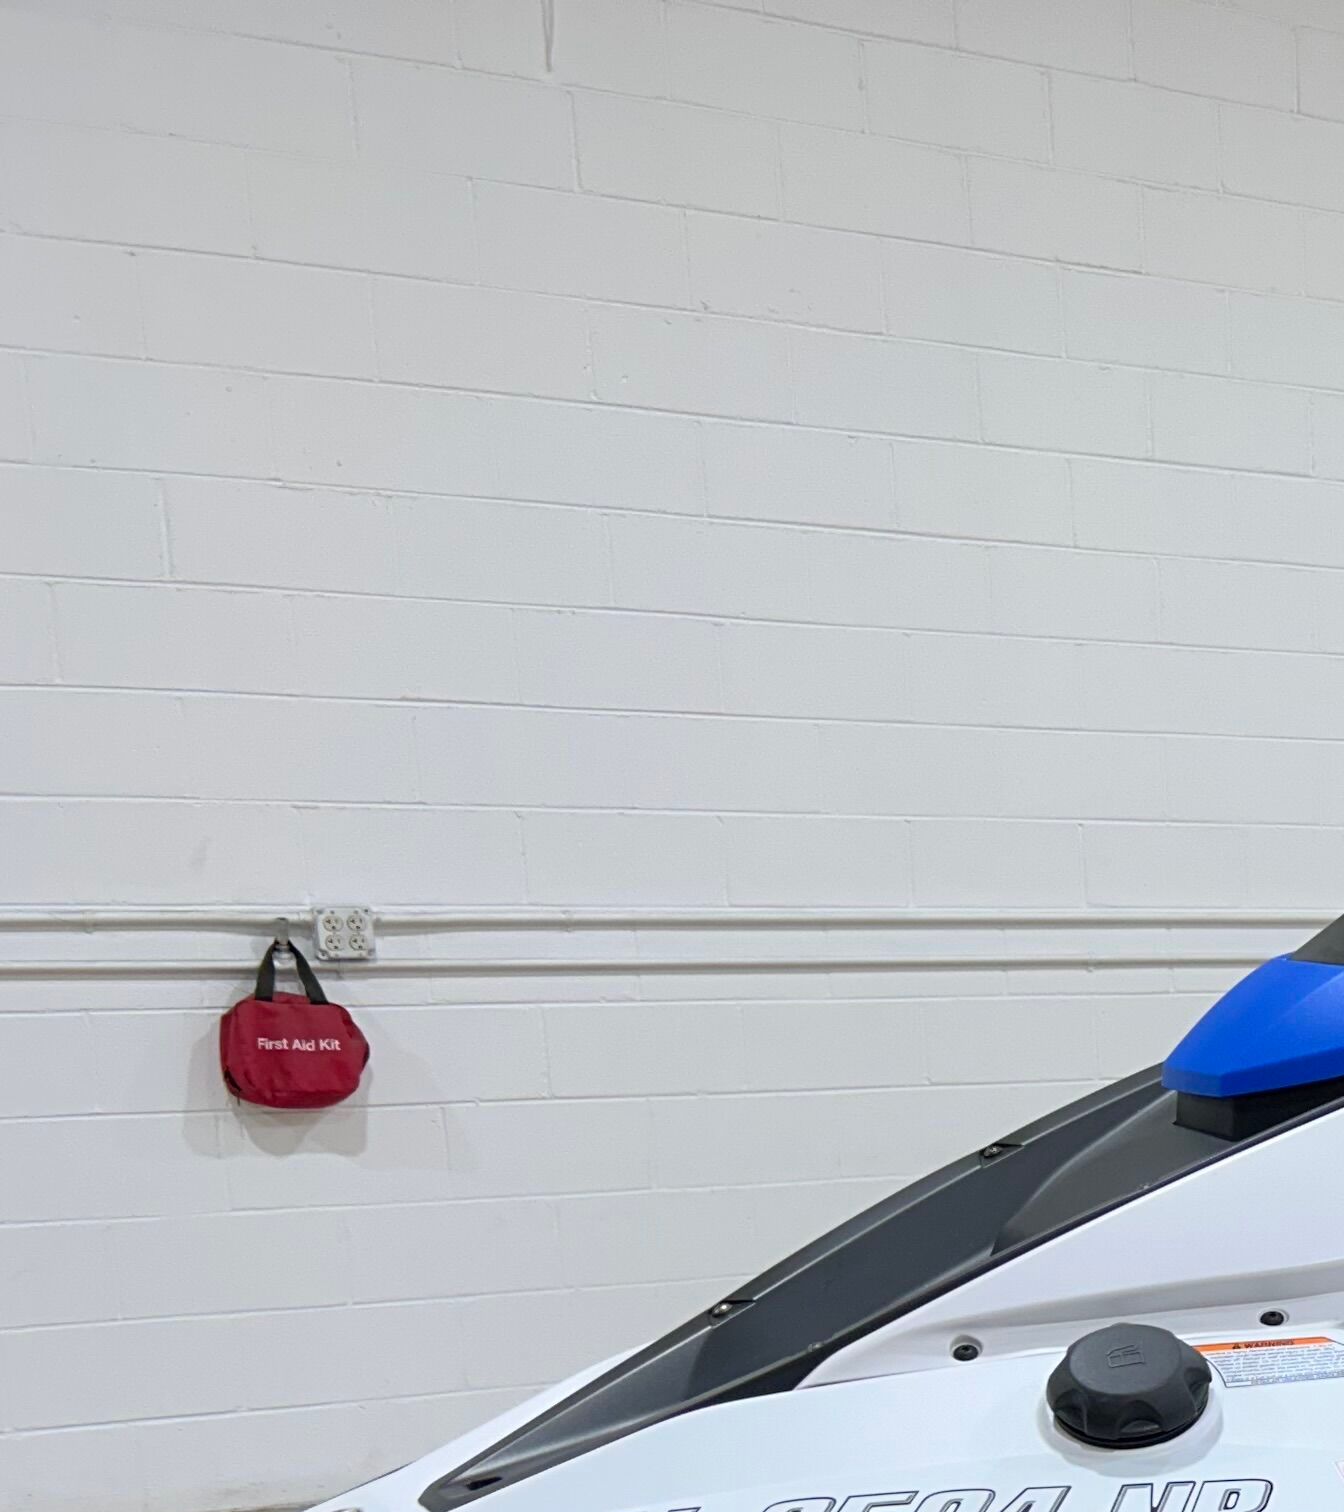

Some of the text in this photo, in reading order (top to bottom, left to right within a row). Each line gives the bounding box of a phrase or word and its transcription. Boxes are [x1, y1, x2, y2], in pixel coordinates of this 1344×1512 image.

[257, 1037, 341, 1051] First Aid Kit
